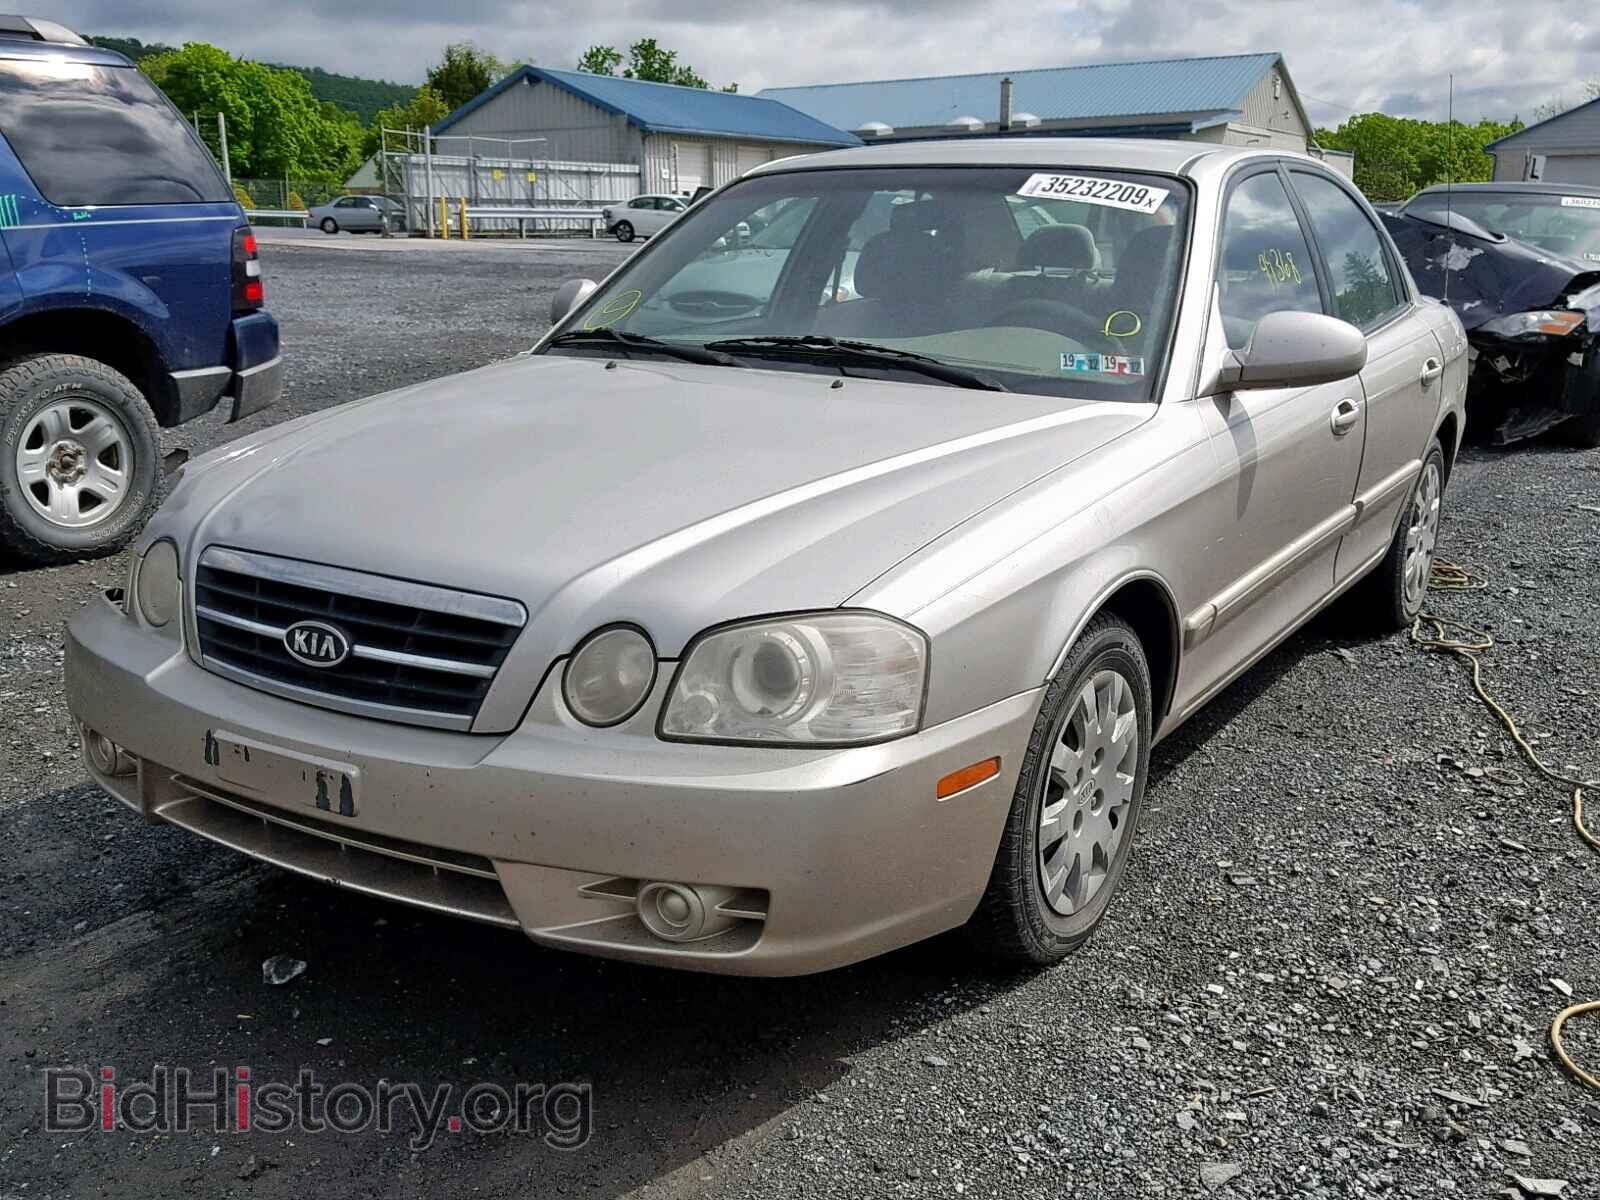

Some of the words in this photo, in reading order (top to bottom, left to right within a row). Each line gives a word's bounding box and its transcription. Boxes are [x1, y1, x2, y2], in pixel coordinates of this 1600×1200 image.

[1063, 354, 1075, 367] 19
[1104, 356, 1117, 370] 19
[293, 629, 336, 660] KIA
